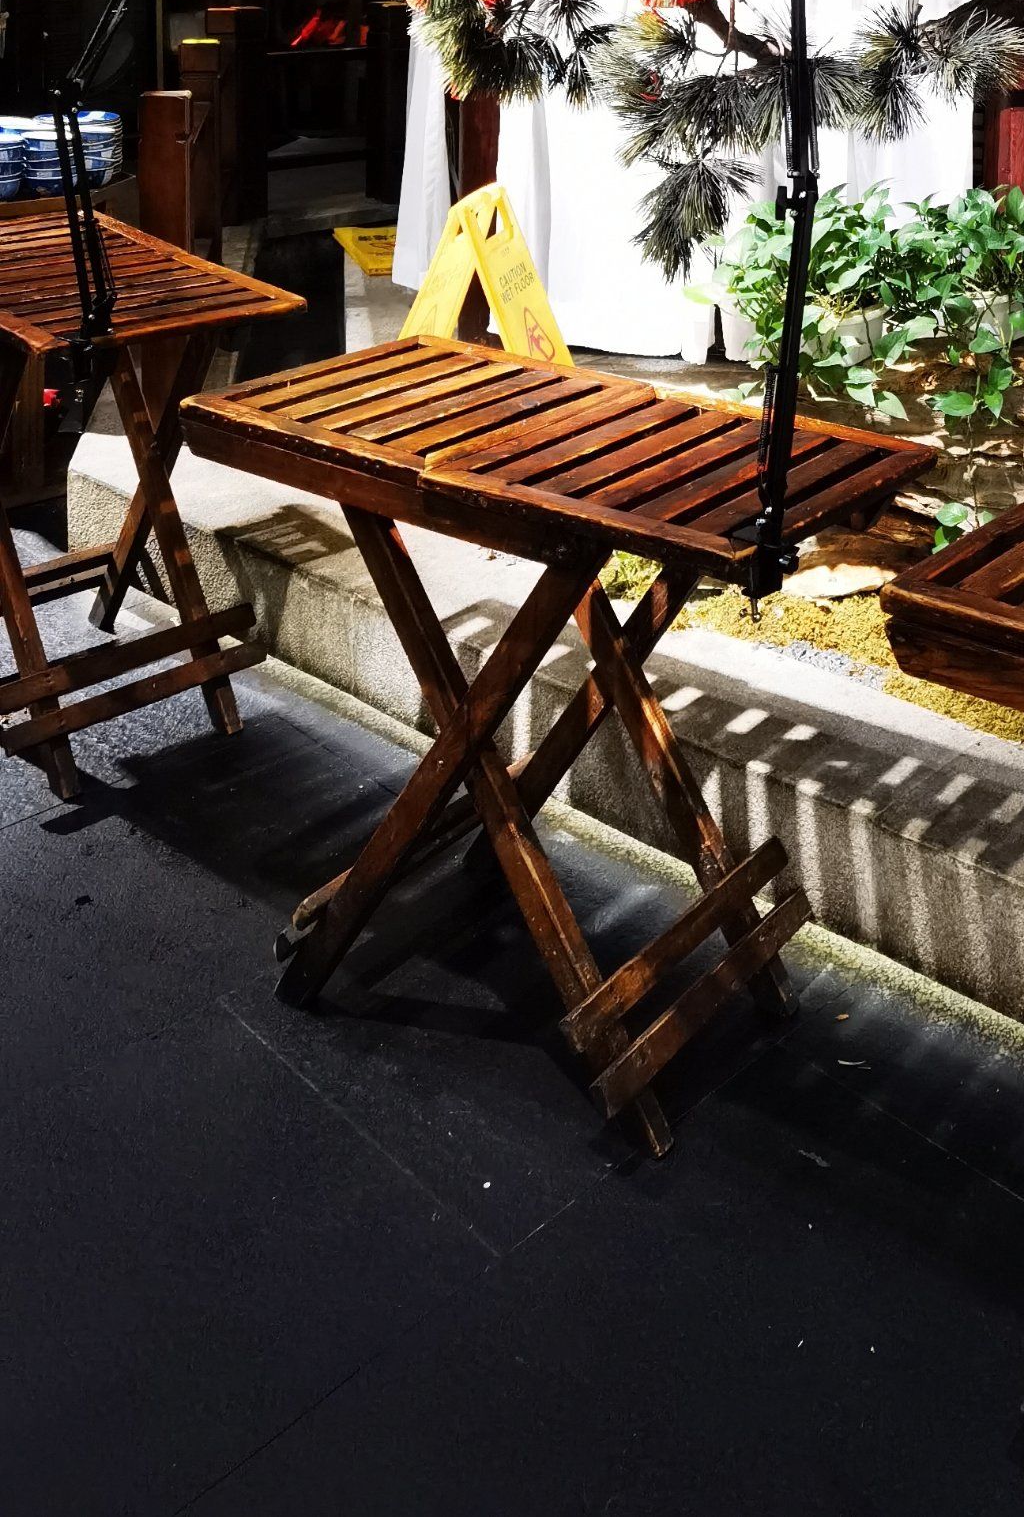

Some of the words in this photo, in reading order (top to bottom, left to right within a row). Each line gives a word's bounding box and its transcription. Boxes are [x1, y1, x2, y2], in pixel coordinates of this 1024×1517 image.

[499, 262, 527, 289] CAUTION
[500, 286, 514, 304] WET
[514, 272, 535, 295] FLOOR
